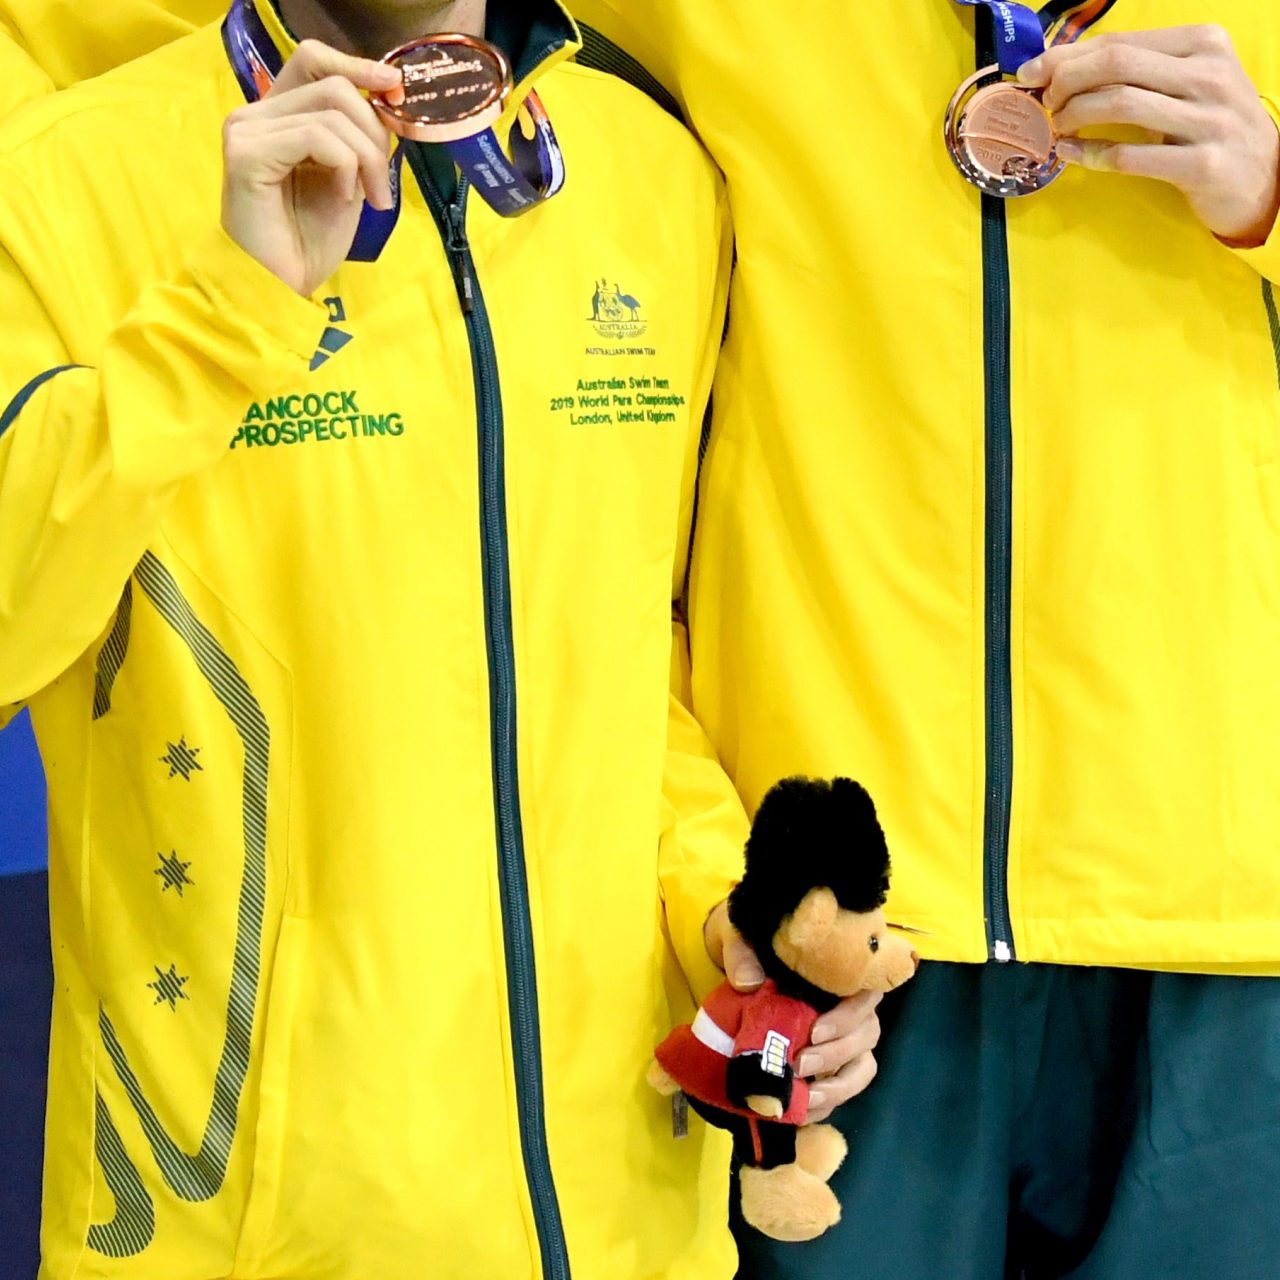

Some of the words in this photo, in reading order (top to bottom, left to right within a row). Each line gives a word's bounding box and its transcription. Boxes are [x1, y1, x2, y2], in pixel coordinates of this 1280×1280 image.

[626, 347, 643, 356] SWIM
[576, 377, 626, 391] Australian
[629, 374, 651, 389] Swim
[243, 390, 359, 423] ANCOCK
[550, 396, 574, 411] 2019
[578, 395, 609, 408] World
[612, 394, 632, 406] Para
[570, 412, 613, 425] London,
[616, 410, 644, 423] United
